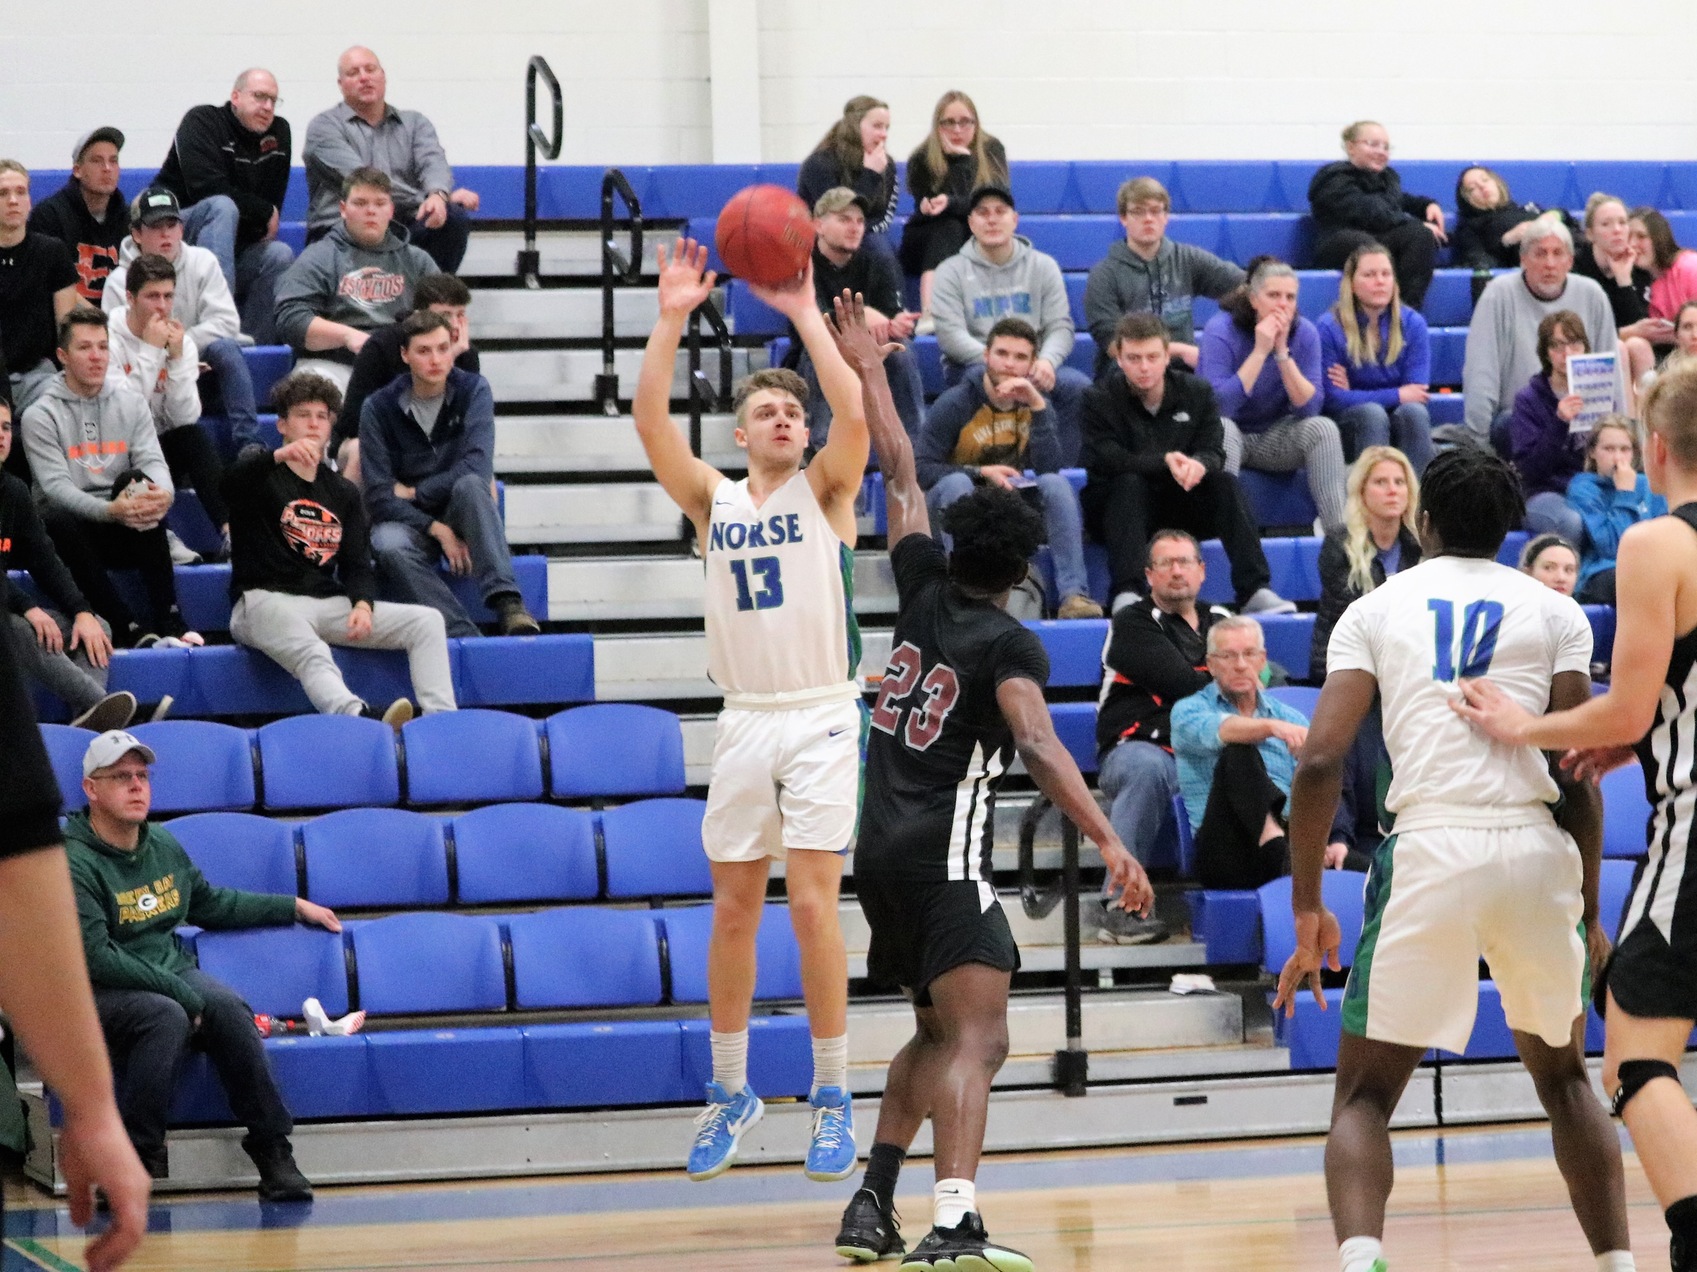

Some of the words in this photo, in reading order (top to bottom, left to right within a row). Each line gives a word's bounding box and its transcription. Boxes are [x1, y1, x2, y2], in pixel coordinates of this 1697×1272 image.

[709, 513, 803, 552] NORSE
[730, 555, 784, 612] 13
[1427, 598, 1504, 683] 10
[871, 640, 960, 752] 23
